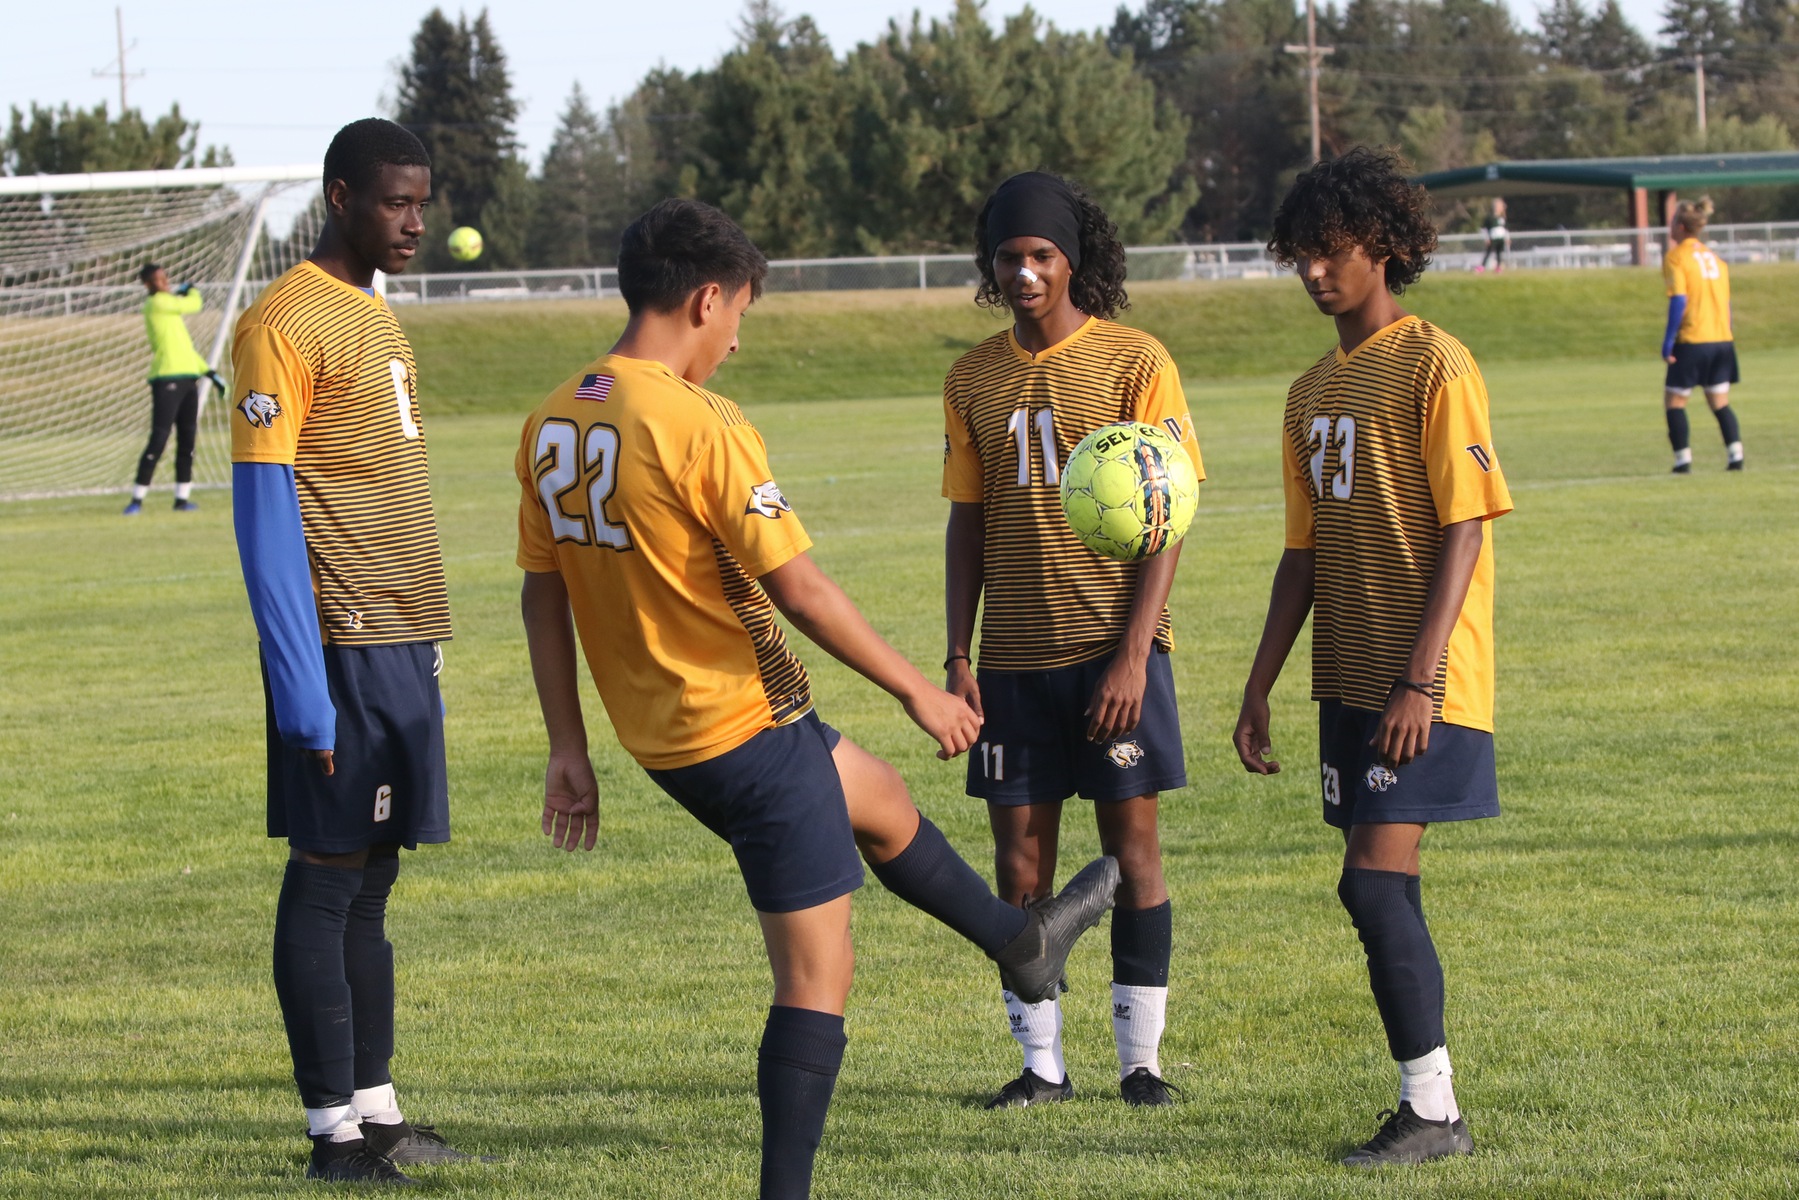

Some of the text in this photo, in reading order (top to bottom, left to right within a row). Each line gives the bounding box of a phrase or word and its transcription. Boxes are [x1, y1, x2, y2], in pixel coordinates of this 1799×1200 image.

[1692, 251, 1720, 279] 13
[1006, 405, 1060, 487] 11
[1307, 413, 1357, 500] 23
[534, 417, 634, 552] 22
[980, 741, 1004, 781] 11
[373, 784, 392, 822] 6
[1322, 762, 1341, 806] 23
